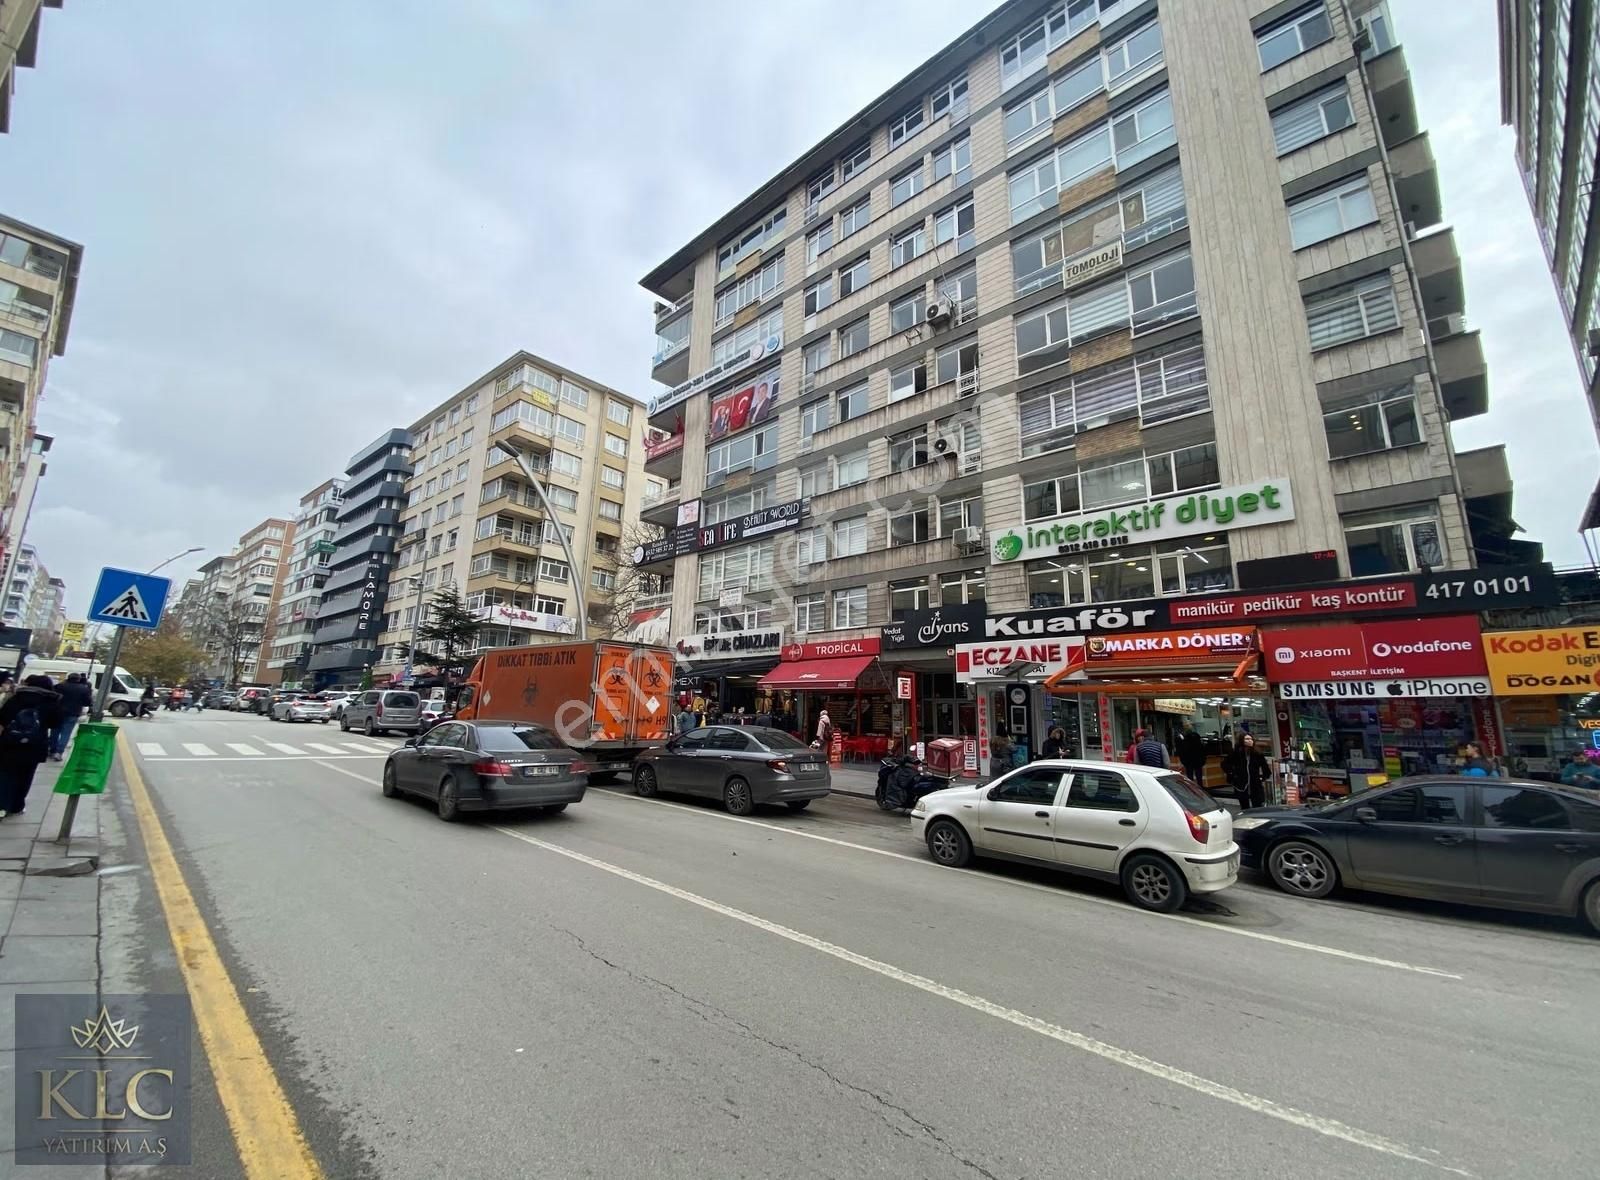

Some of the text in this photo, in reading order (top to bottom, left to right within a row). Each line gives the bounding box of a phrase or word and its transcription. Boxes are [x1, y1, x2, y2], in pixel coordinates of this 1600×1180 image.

[1027, 484, 1281, 547] interaktif diyet
[1426, 575, 1531, 599] 417 0101
[358, 571, 376, 631] LAMORE
[1177, 587, 1405, 617] manikür pedikür kaş kontür
[918, 617, 969, 643] alyans
[985, 607, 1155, 637] Kuaför
[815, 641, 864, 655] TROPİCAL
[1106, 633, 1244, 653] MARKA DÖNER
[1390, 639, 1472, 654] vodafone
[1490, 633, 1580, 654] Kodak
[554, 650, 577, 665] ATIK
[972, 644, 1062, 665] ECZANE
[1566, 654, 1600, 667] Digi
[1331, 667, 1405, 677] BAŞKENT İLETİŞİM
[1283, 682, 1376, 698] SAMSUNG
[1407, 680, 1488, 697] iPhone
